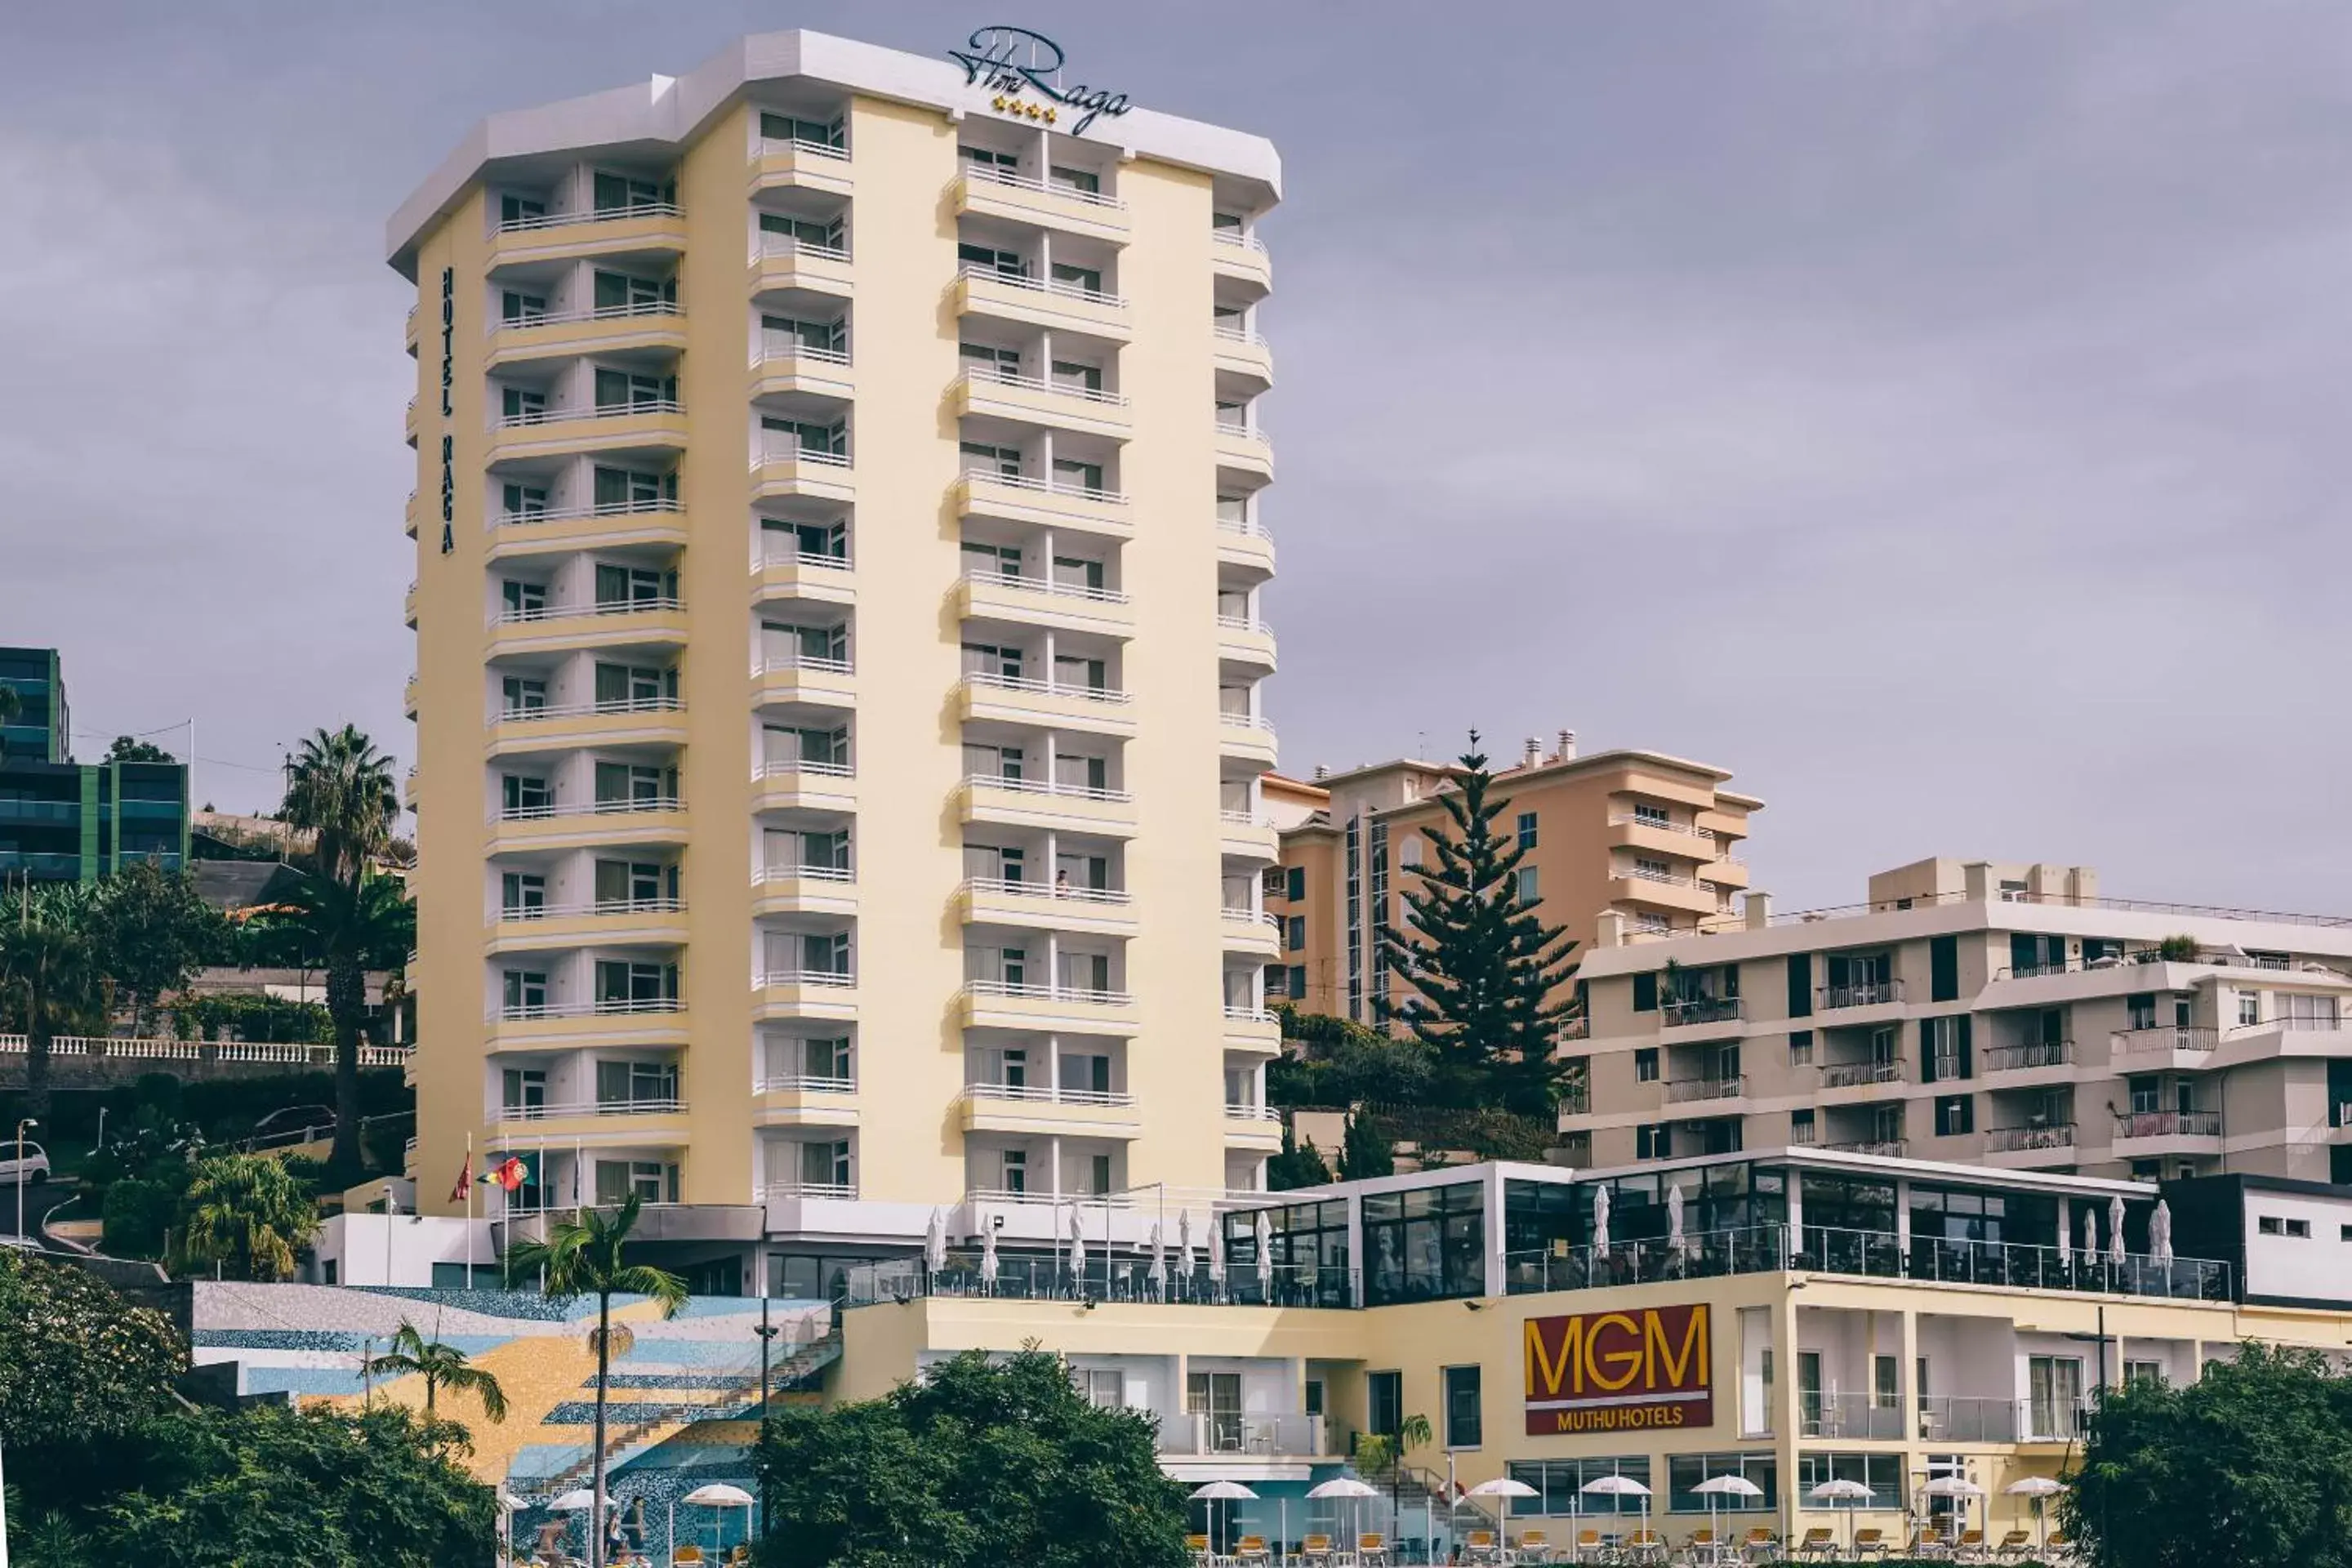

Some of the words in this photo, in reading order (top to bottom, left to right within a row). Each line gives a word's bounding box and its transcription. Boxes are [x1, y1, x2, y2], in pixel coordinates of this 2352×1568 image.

[969, 26, 1131, 136] Raga
[441, 435, 454, 555] RAGA
[1525, 1304, 1708, 1396] MGM
[1557, 1410, 1616, 1431] MUTHU
[1619, 1406, 1683, 1428] HOTELS
